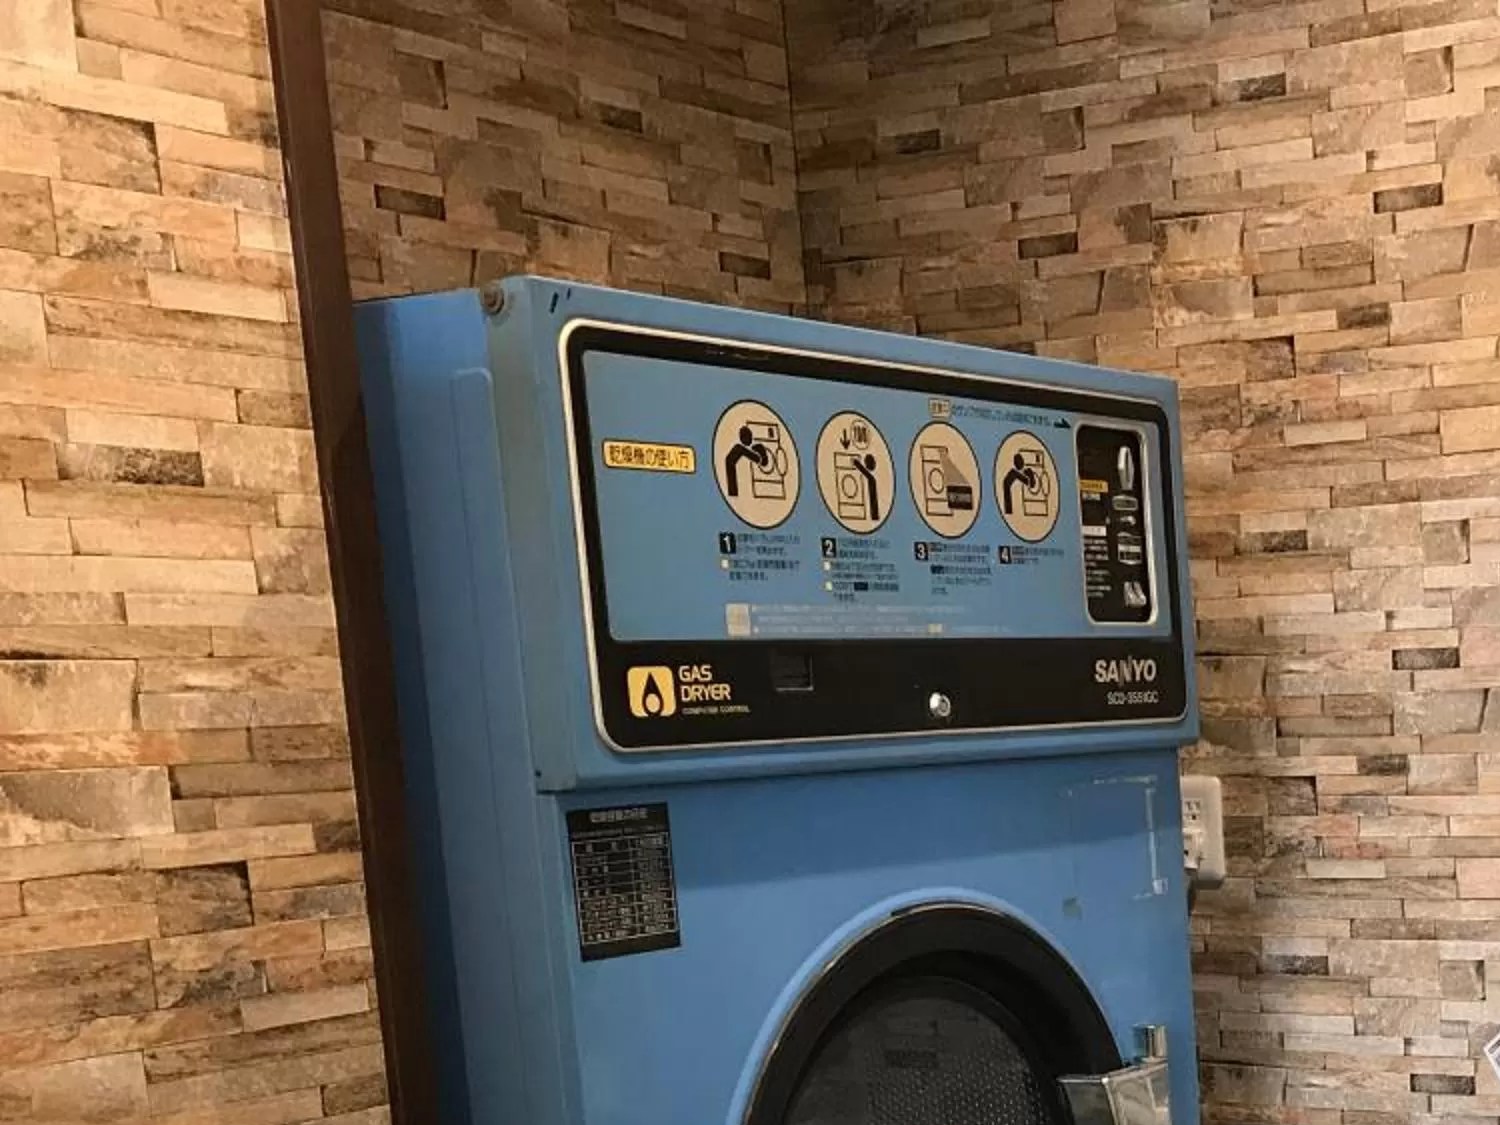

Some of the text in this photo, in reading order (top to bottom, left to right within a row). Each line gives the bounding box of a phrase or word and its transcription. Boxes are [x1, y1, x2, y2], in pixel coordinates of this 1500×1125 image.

[678, 664, 714, 683] GAS
[1094, 656, 1157, 686] SANYO
[681, 683, 732, 702] DRYER
